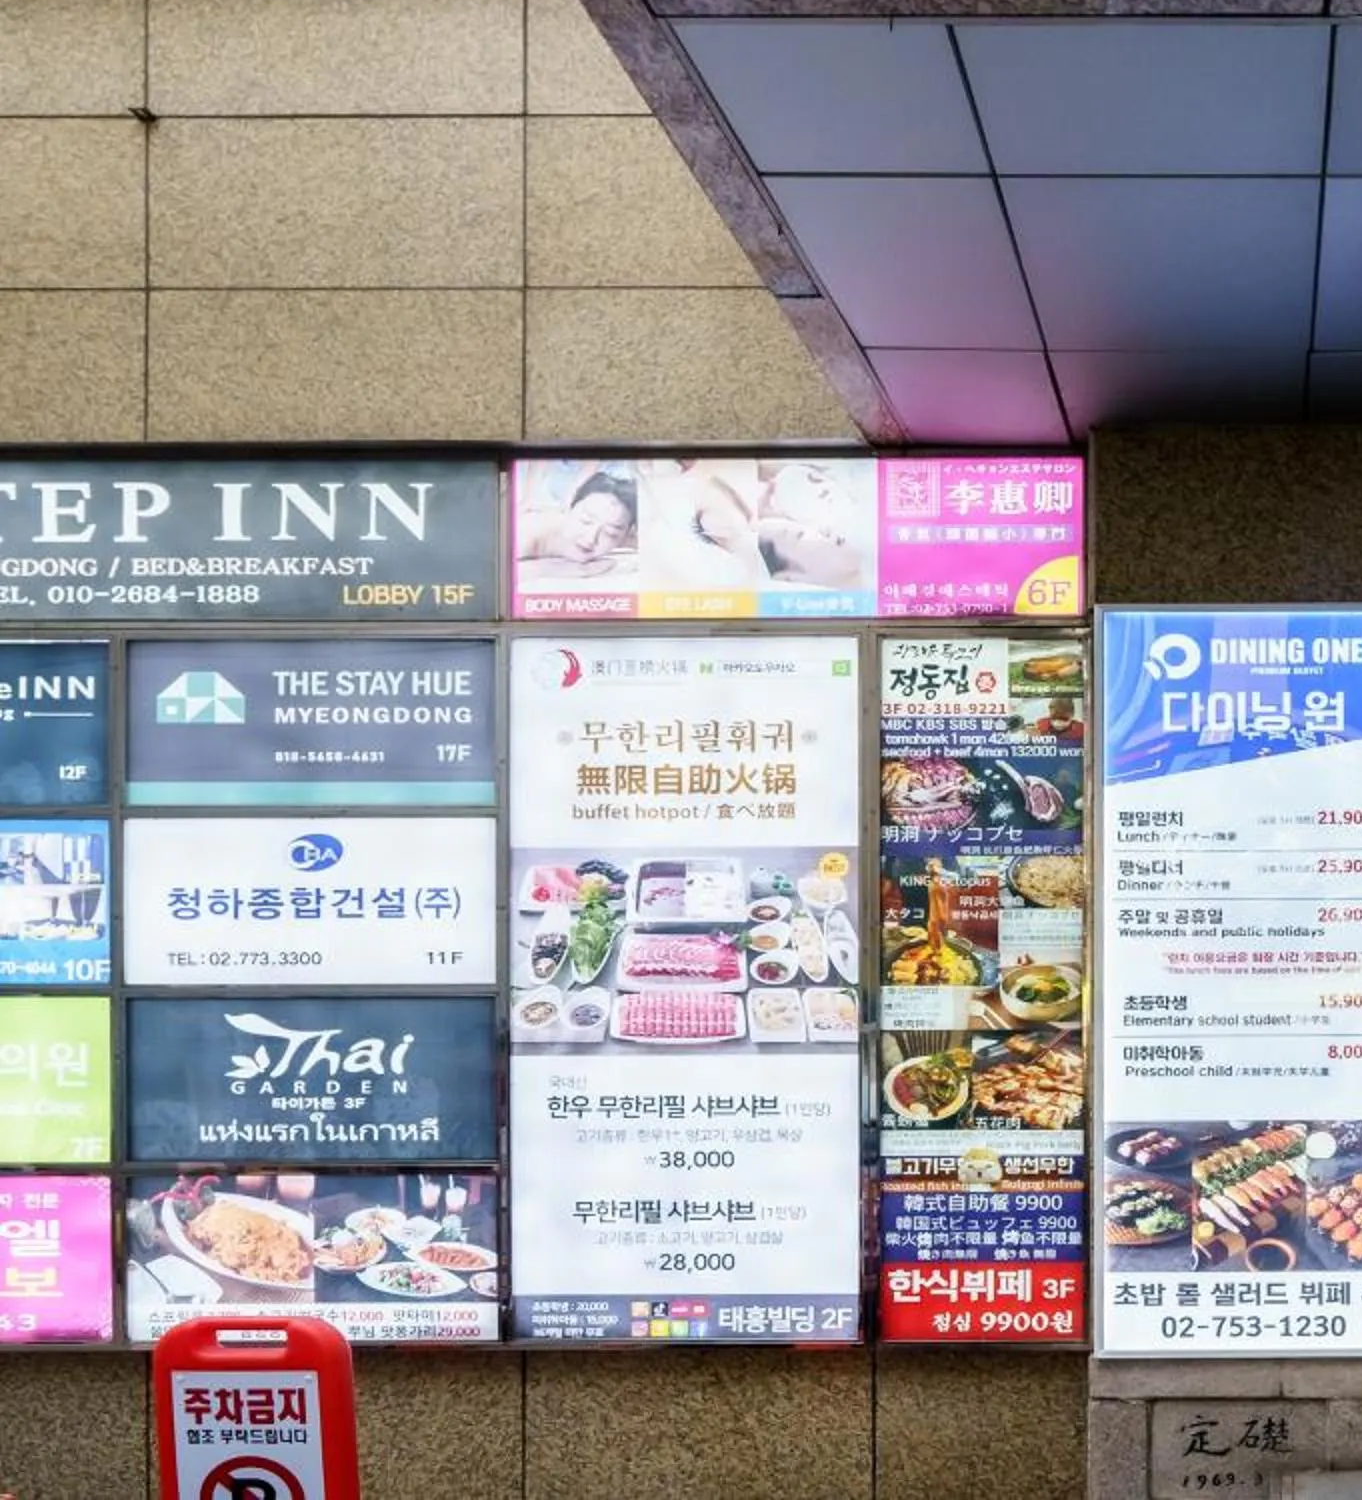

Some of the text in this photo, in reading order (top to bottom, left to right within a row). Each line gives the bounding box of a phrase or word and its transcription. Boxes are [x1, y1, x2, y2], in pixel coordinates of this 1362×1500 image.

[213, 483, 433, 542] INN
[131, 557, 374, 577] BED&BREAKFAST
[47, 585, 260, 605] 010-2684-1888
[343, 585, 423, 605] LOBBY
[432, 585, 475, 605] 15F
[1028, 580, 1071, 605] 6F
[1210, 638, 1305, 665] DINING
[273, 671, 472, 696] THE STAY HUE
[889, 664, 971, 700] 정동집
[274, 707, 472, 724] MYEONGDONG
[1161, 690, 1345, 733] 다이닝 원
[436, 744, 472, 762] 17F
[576, 762, 797, 796] 無限自助火锅
[572, 802, 629, 820] buffet
[635, 802, 699, 822] hotpot
[166, 886, 462, 922] 청하종합건설(주)
[64, 959, 112, 981] 10F
[426, 951, 464, 966] 11F
[223, 1013, 415, 1079] Thai
[231, 1080, 408, 1095] GARDEN
[344, 1097, 367, 1109] 3F
[547, 1095, 591, 1120] 한우
[596, 1095, 686, 1120] 무한리필
[691, 1095, 782, 1120] 샤브샤브
[572, 1199, 662, 1225] 무한리필
[667, 1199, 757, 1225] 샤브샤브
[1015, 1194, 1064, 1212] 9900
[1037, 1215, 1077, 1230] 9900
[887, 1268, 1076, 1304] 한식뷔페 3F
[1113, 1281, 1167, 1307] 초밥
[1175, 1281, 1201, 1307] 롤
[1211, 1281, 1289, 1307] 샐러드
[1298, 1280, 1351, 1306] 뷔페
[718, 1305, 853, 1334] 태흥빌딩 2F
[979, 1309, 1074, 1333] 9900원
[1160, 1315, 1347, 1339] 02-753-1230
[184, 1387, 307, 1426] 주차금지
[221, 1429, 308, 1445] 부탁드립니다
